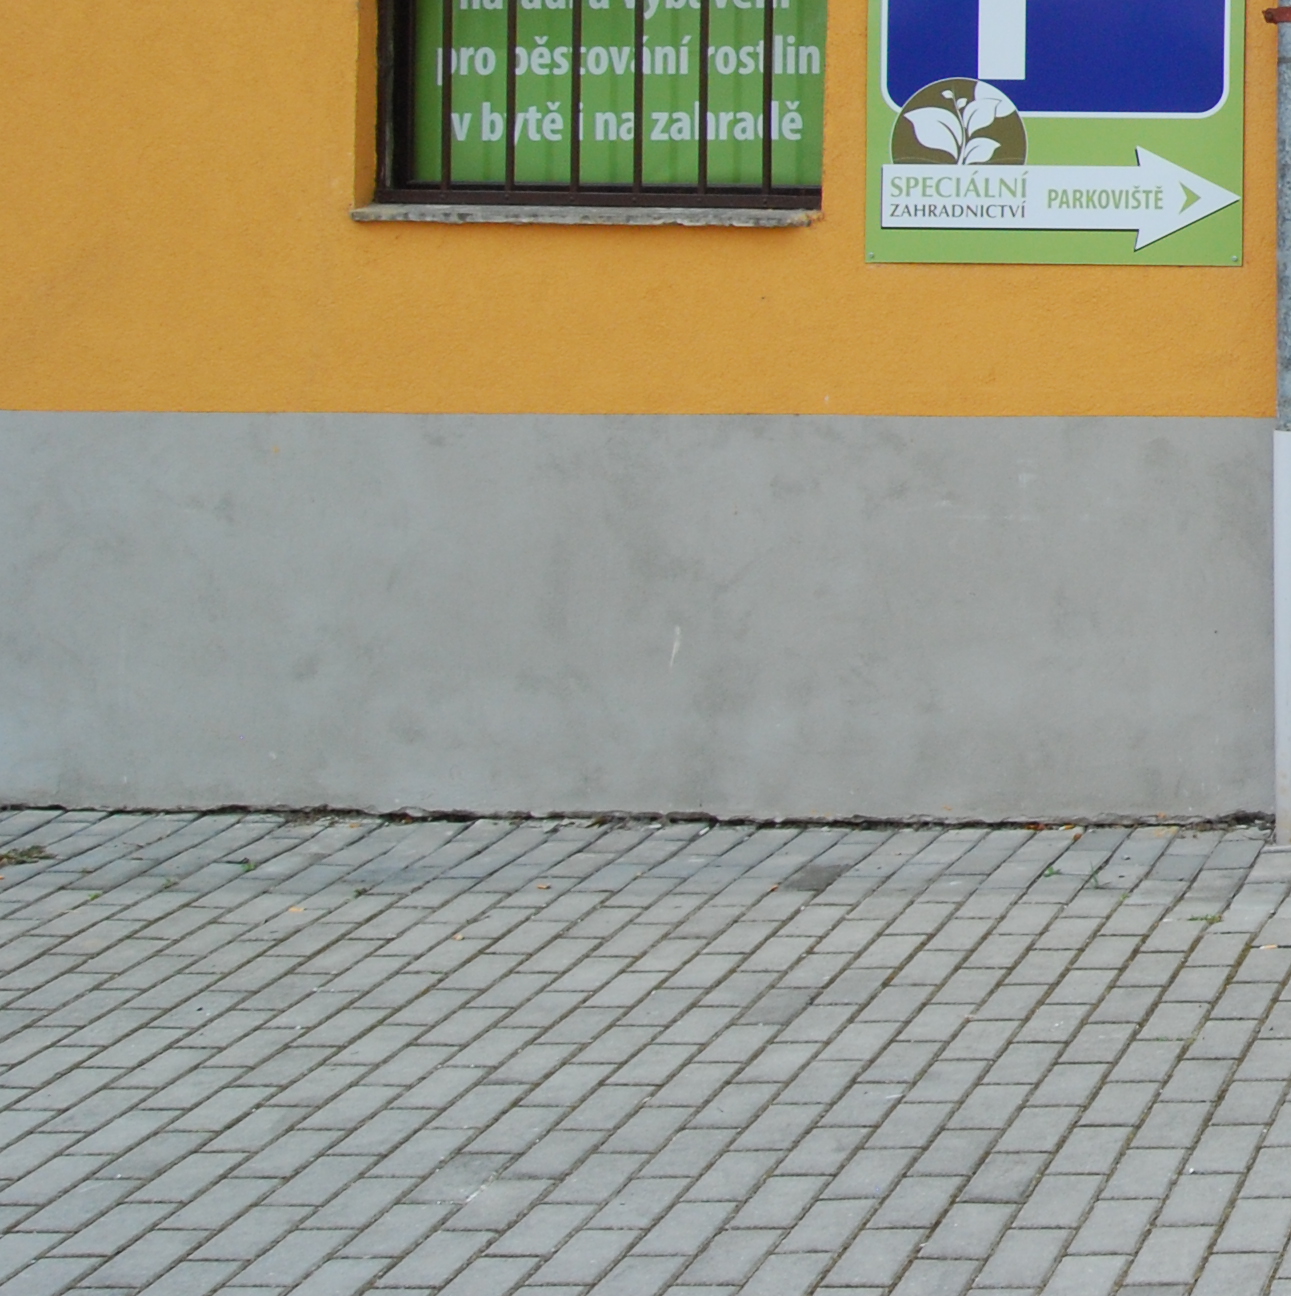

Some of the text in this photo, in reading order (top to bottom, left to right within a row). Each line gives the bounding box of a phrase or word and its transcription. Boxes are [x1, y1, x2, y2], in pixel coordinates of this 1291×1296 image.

[436, 46, 496, 86] pro
[450, 112, 473, 142] v
[594, 111, 636, 142] na
[650, 100, 804, 141] zahradě
[889, 170, 1029, 199] SPECIÁLNÍ
[1046, 185, 1164, 211] PARKOVIŠTĚ
[889, 200, 1027, 220] ZAHRADNICTVÍ
